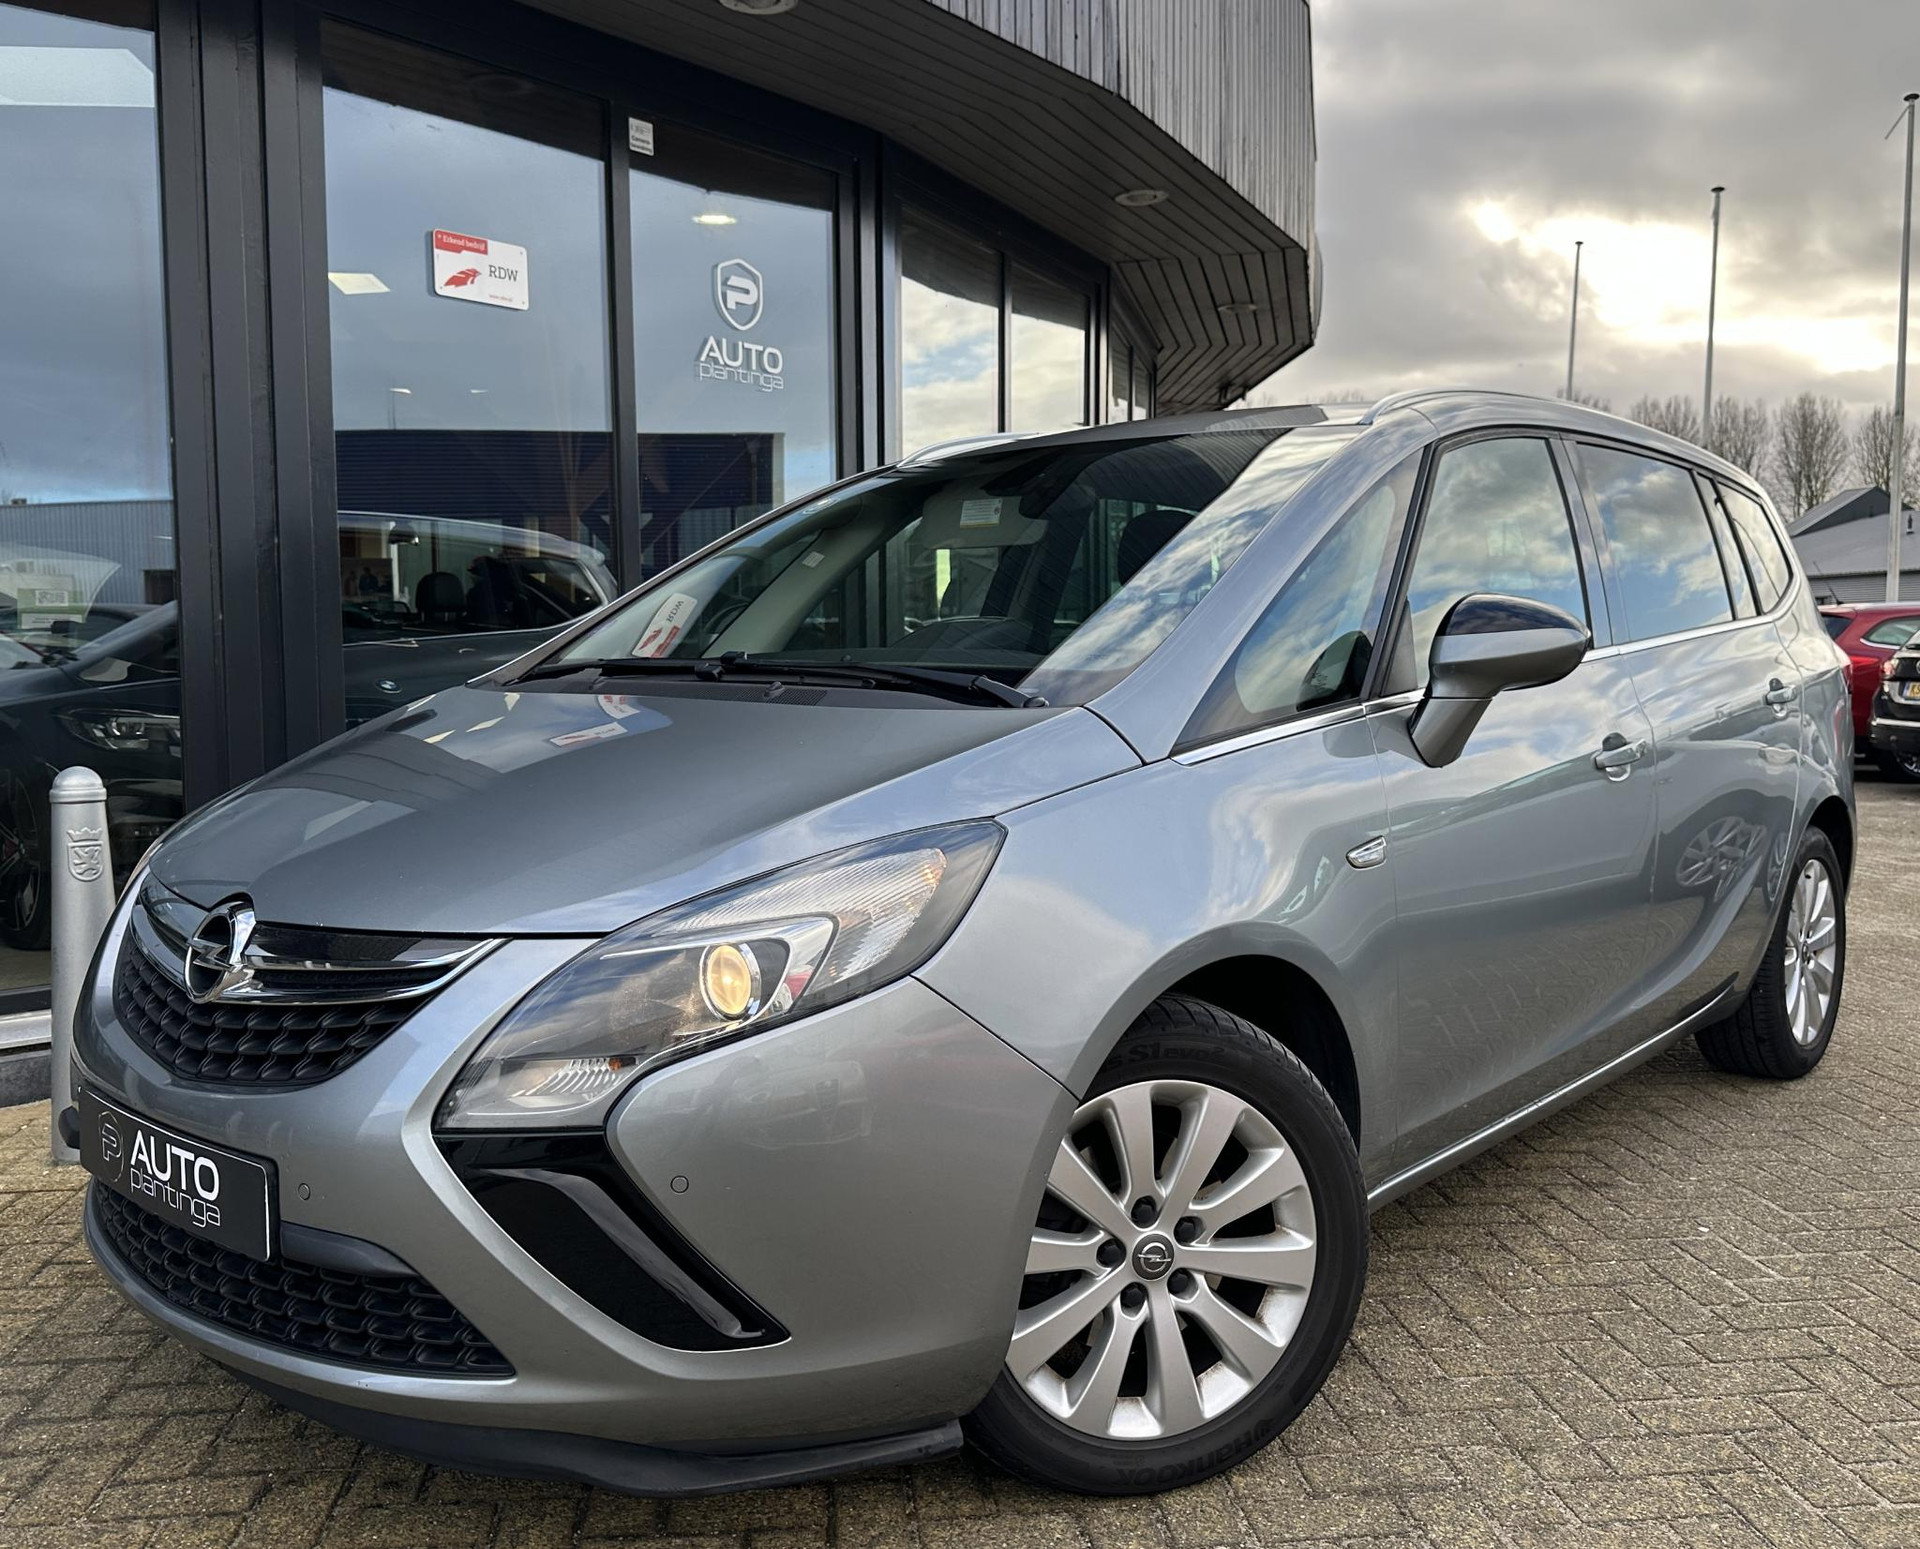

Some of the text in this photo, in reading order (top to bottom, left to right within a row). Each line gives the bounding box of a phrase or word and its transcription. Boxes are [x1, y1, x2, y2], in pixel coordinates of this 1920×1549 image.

[488, 264, 519, 283] RDW
[700, 335, 783, 374] AUTO
[700, 361, 784, 392] plantinga
[130, 1129, 220, 1201] AUTO
[130, 1167, 221, 1228] plantinga
